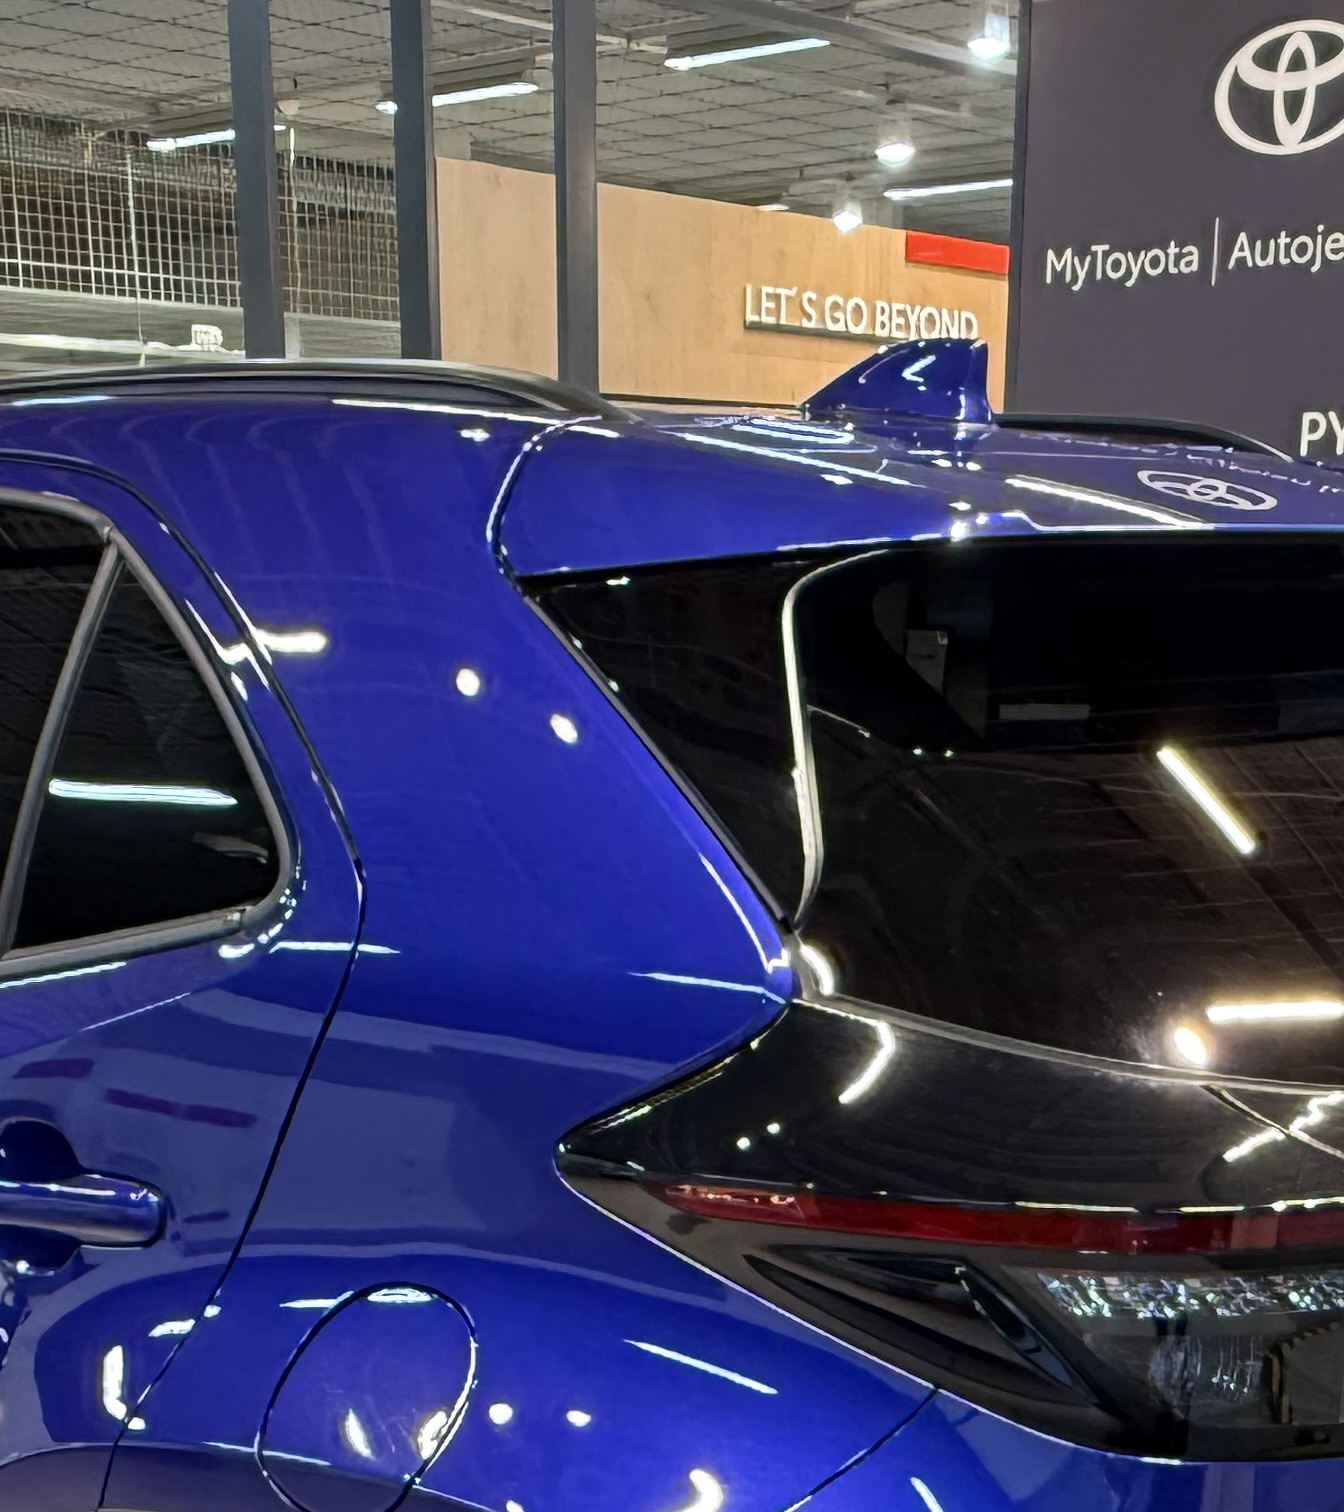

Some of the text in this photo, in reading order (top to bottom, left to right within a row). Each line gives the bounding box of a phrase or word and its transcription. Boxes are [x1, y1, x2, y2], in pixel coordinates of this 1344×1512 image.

[1044, 244, 1200, 293] MyToyota
[824, 294, 869, 334] GO
[874, 299, 980, 341] BEYOND
